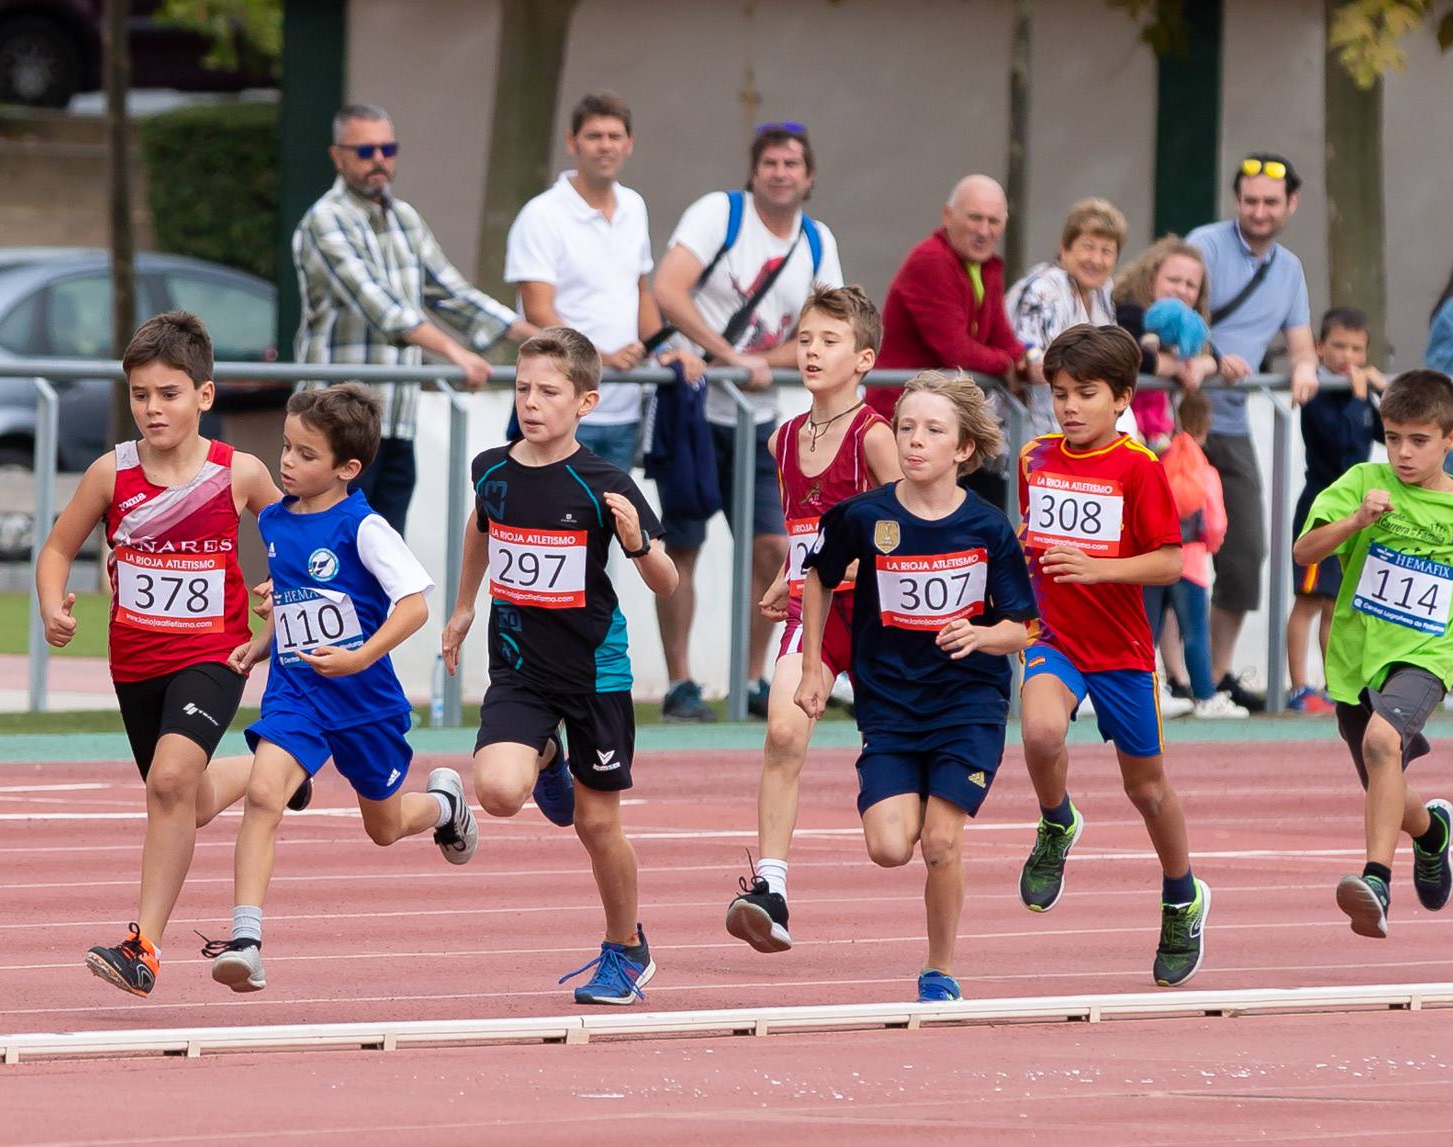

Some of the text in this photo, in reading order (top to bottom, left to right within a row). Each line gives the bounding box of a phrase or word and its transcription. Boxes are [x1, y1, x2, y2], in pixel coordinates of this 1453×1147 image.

[1037, 477, 1113, 494] LA RIOJA ATLETISMO
[1039, 494, 1102, 535] 308
[491, 528, 576, 545] LA RIOJA ATLETISMO
[126, 553, 215, 570] LA RIOJA ATLETISMO
[499, 548, 566, 588] 297
[887, 554, 979, 570] LA RIOJA ATLETISMO
[1395, 554, 1451, 578] HEMAFIX
[135, 574, 209, 613] 378
[899, 572, 970, 610] 307
[1371, 569, 1439, 616] 114
[280, 604, 344, 648] 110
